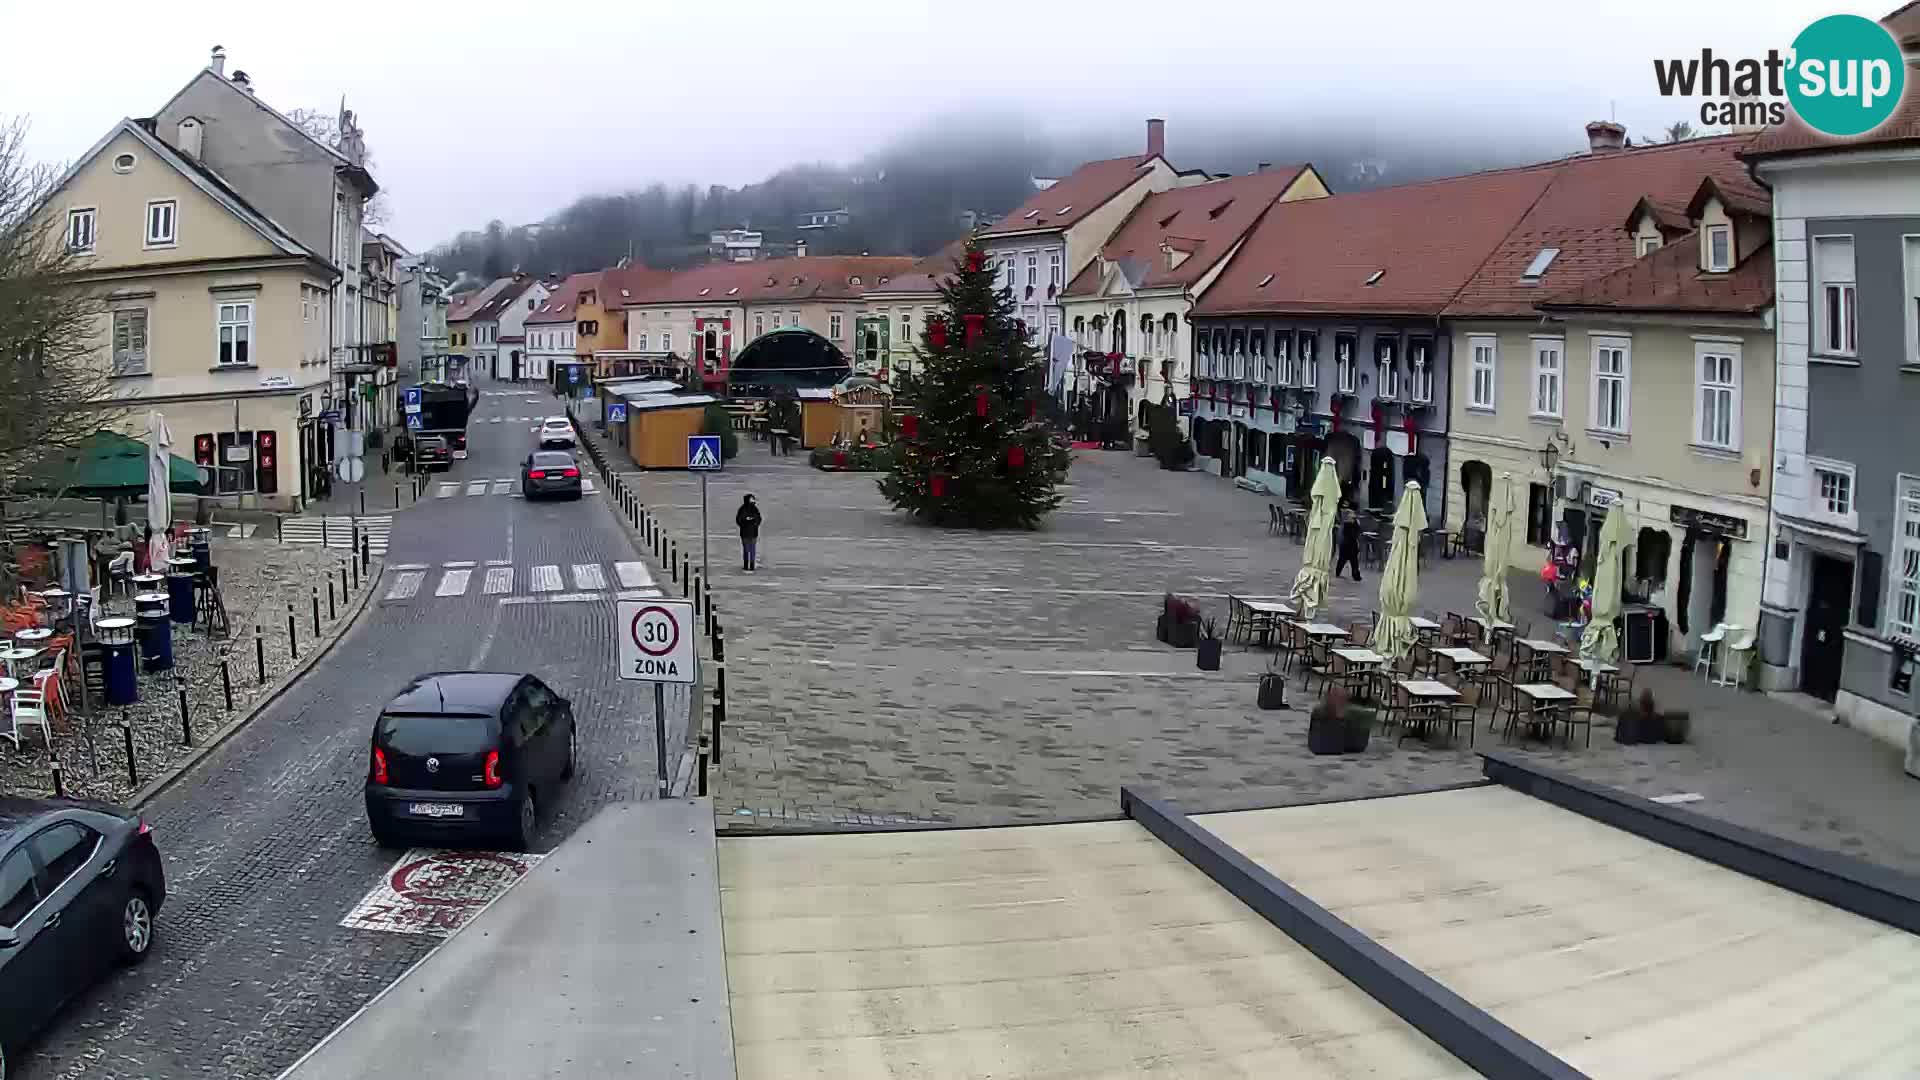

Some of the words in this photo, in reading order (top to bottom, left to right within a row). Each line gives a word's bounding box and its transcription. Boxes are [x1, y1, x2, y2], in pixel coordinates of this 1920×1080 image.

[409, 391, 417, 402] P
[644, 622, 668, 643] 30
[635, 659, 678, 676] ZONA
